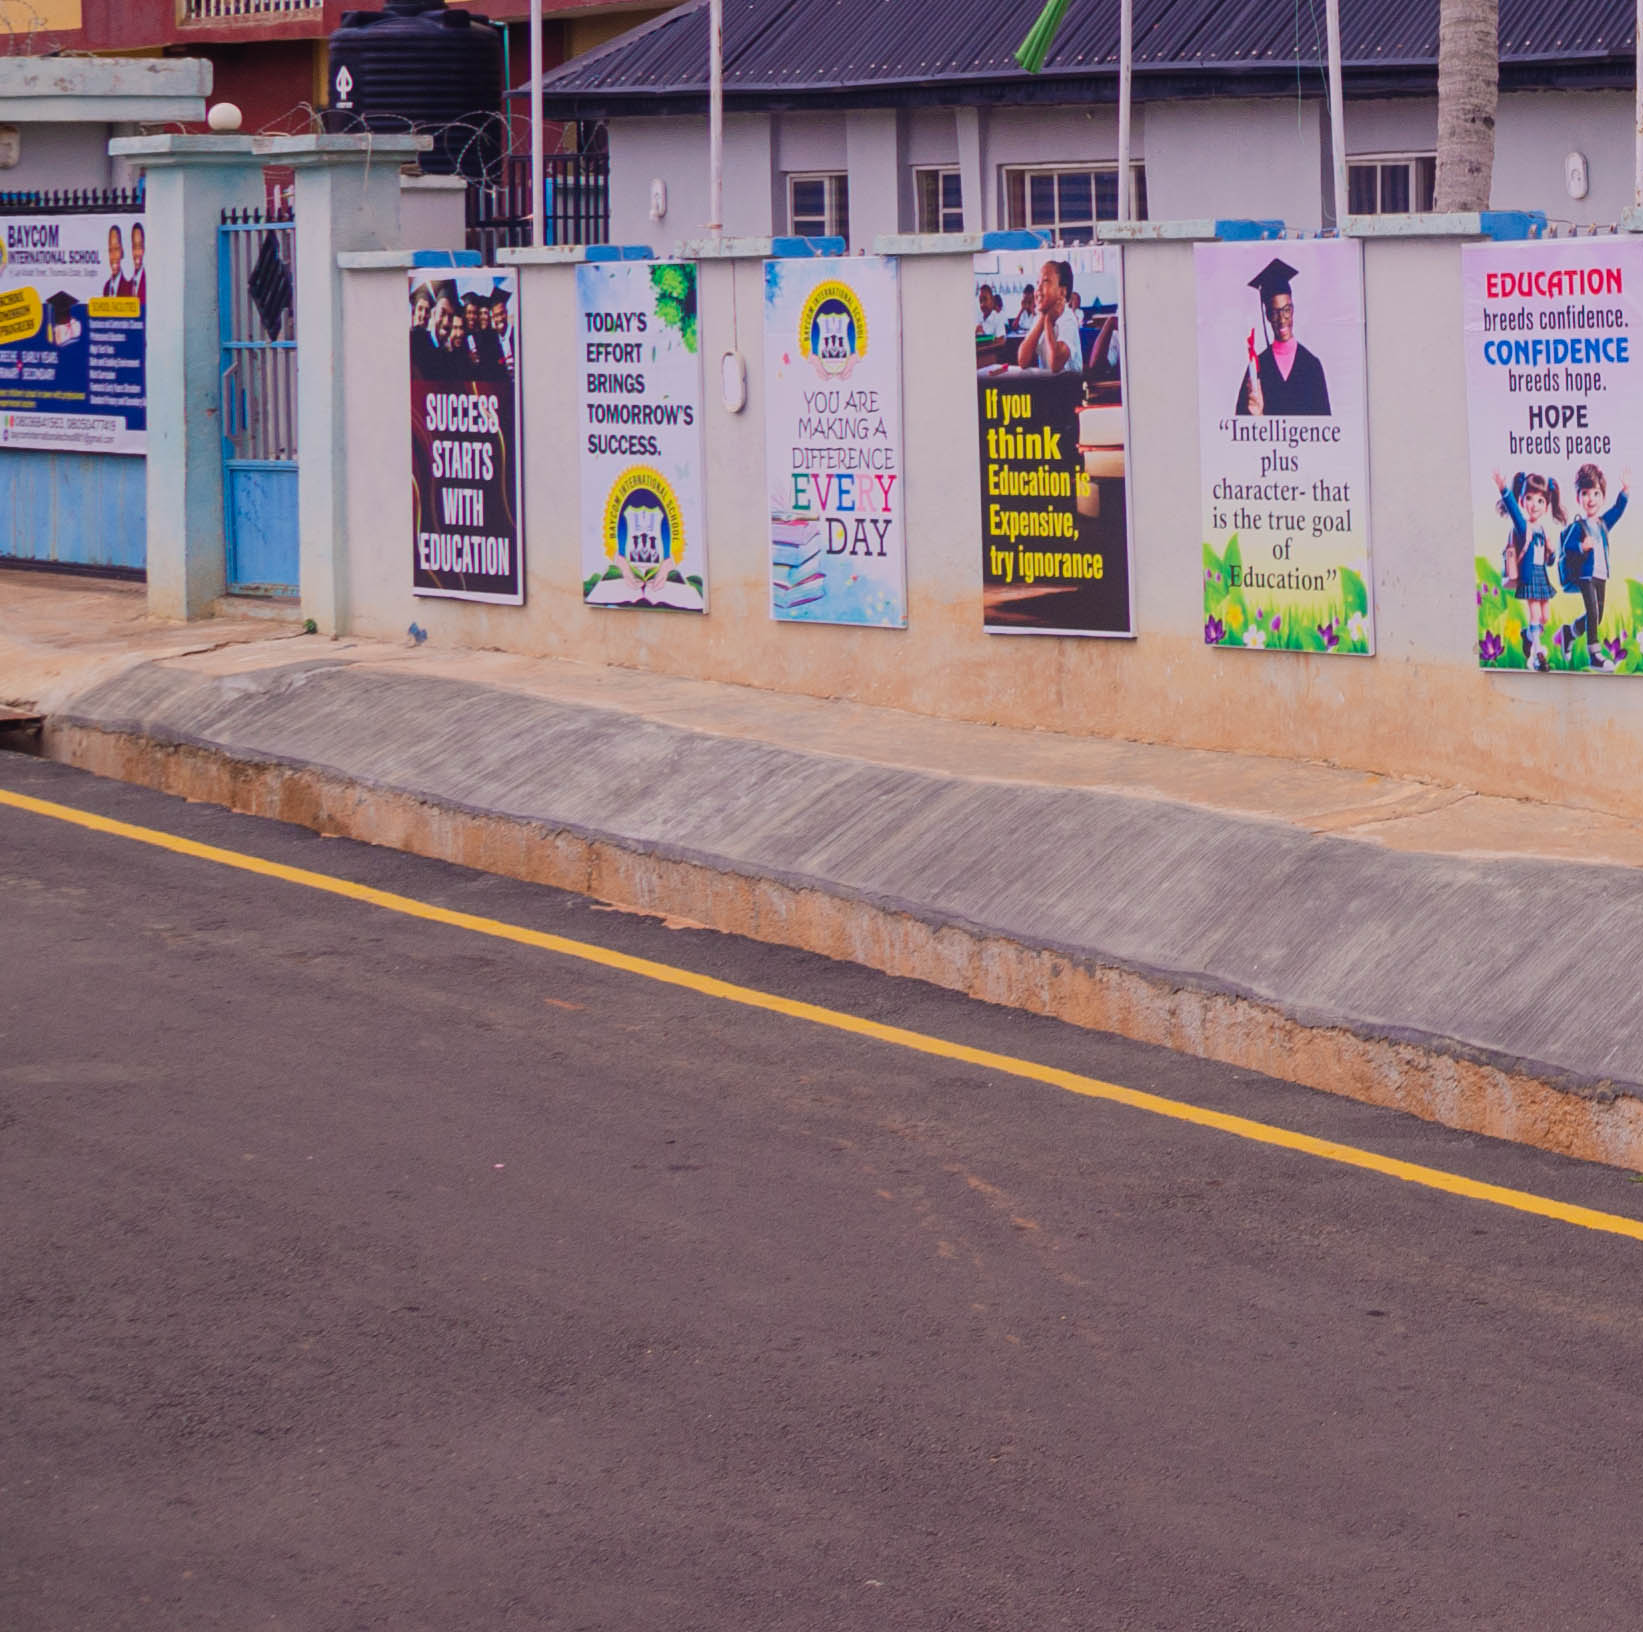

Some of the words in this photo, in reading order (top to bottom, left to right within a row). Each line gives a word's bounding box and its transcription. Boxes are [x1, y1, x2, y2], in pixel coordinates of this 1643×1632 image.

[8, 225, 59, 248] BAYCOM
[8, 250, 66, 264] INTERNATIONAL
[69, 250, 101, 264] SCHOOL
[1486, 268, 1623, 299] EDUCATION
[585, 312, 647, 333] TODAY'S
[1483, 308, 1535, 333] breeds
[1539, 306, 1629, 330] confidence.
[586, 343, 642, 363] EFFORT
[1483, 337, 1629, 368] CONFIDENCE
[587, 373, 645, 394] BRINGS
[1509, 368, 1560, 393] breeds
[1564, 368, 1607, 396] hope.
[426, 393, 499, 434] SUCCESS
[587, 403, 694, 426] TOMORROW'S
[803, 391, 840, 414] YOU
[844, 391, 880, 413] ARE
[985, 388, 997, 419] If
[1001, 392, 1031, 419] you
[798, 417, 870, 440] MAKING
[873, 418, 888, 440] A
[1528, 405, 1589, 431] HOPE
[588, 434, 661, 456] SUCCESS.
[986, 426, 1062, 460] think
[1218, 419, 1341, 448] “Intelligence
[1509, 430, 1561, 455] breeds
[1566, 434, 1611, 461] peace
[432, 440, 494, 481] STARTS
[792, 447, 895, 470] DIFFERENCE
[1260, 449, 1299, 477] plus
[791, 473, 897, 513] EVERY
[988, 464, 1070, 497] Education
[1075, 468, 1091, 498] is
[1212, 477, 1306, 502] character-
[1312, 478, 1350, 502] that
[442, 487, 484, 527] WITH
[1212, 506, 1227, 530] is
[1232, 507, 1262, 531] the
[1267, 509, 1306, 532] true
[1312, 508, 1352, 533] goal
[825, 517, 893, 556] DAY
[989, 504, 1079, 543] Expensive,
[419, 533, 510, 576] EDUCATION
[1272, 537, 1293, 561] of
[990, 544, 1014, 584] try
[1018, 545, 1104, 583] ignorance
[1228, 565, 1337, 592] Education”
